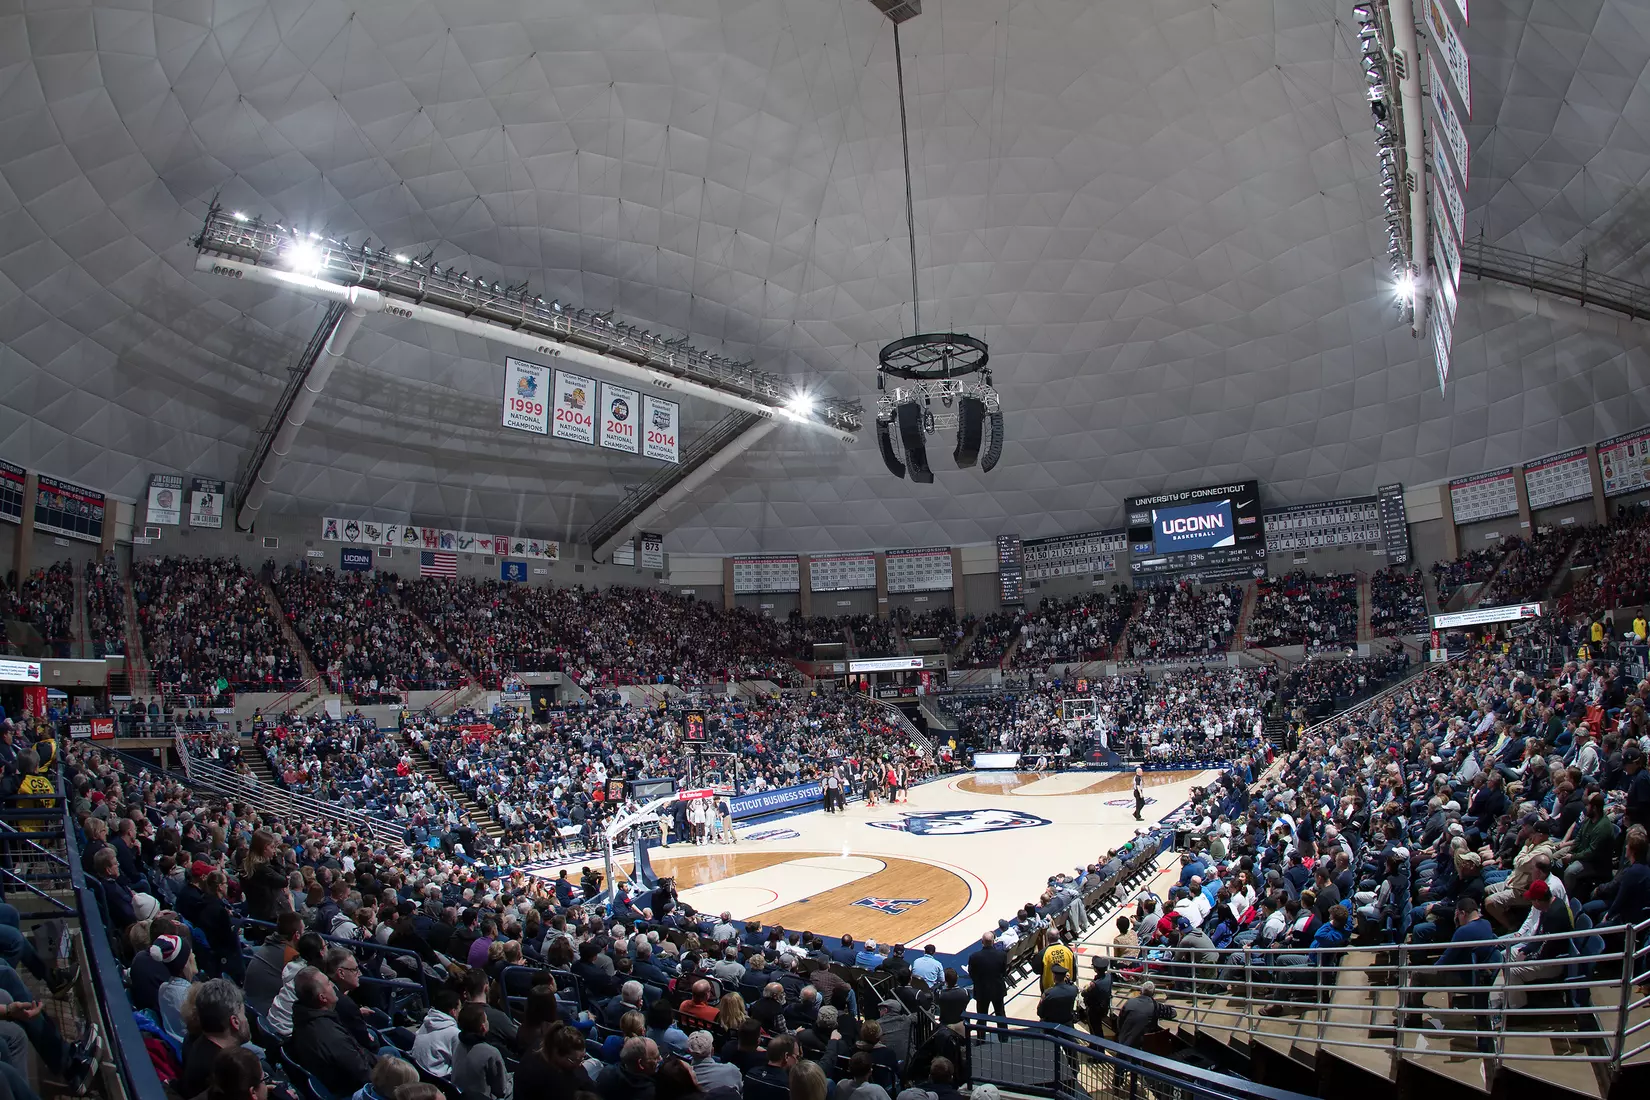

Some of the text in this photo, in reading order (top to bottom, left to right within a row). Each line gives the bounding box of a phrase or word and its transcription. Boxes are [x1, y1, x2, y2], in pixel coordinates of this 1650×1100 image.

[517, 367, 539, 376] Basketball
[565, 380, 586, 388] Basketball
[611, 392, 630, 400] Basketball
[510, 398, 542, 416] 1999
[511, 413, 540, 423] NATIONAL
[556, 408, 591, 427] 2004
[508, 420, 542, 432] CHAMPIONS
[560, 423, 587, 434] NATIONAL
[607, 420, 632, 436] 2011
[557, 430, 590, 442] CHAMPIONS
[606, 434, 632, 444] NATIONAL
[648, 431, 675, 447] 2014
[604, 441, 635, 451] CHAMPIONS
[649, 444, 673, 454] NATIONAL
[647, 451, 675, 461] CHAMPIONS
[1543, 449, 1583, 464] CHAMPIONSHIP
[1469, 469, 1509, 481] CHAMPIONSHIP
[41, 477, 101, 499] NCAA CHAMPIONSHIP
[1135, 493, 1178, 506] UNIVERSITY
[1191, 484, 1245, 498] CONNECTICUT
[1162, 513, 1224, 535] UCONN
[364, 524, 381, 542] UCF
[1173, 532, 1215, 541] BASKETBALL
[645, 542, 659, 551] 873
[1255, 549, 1265, 557] 43
[70, 724, 91, 733] BEAR'S
[764, 791, 798, 806] BUSINESS
